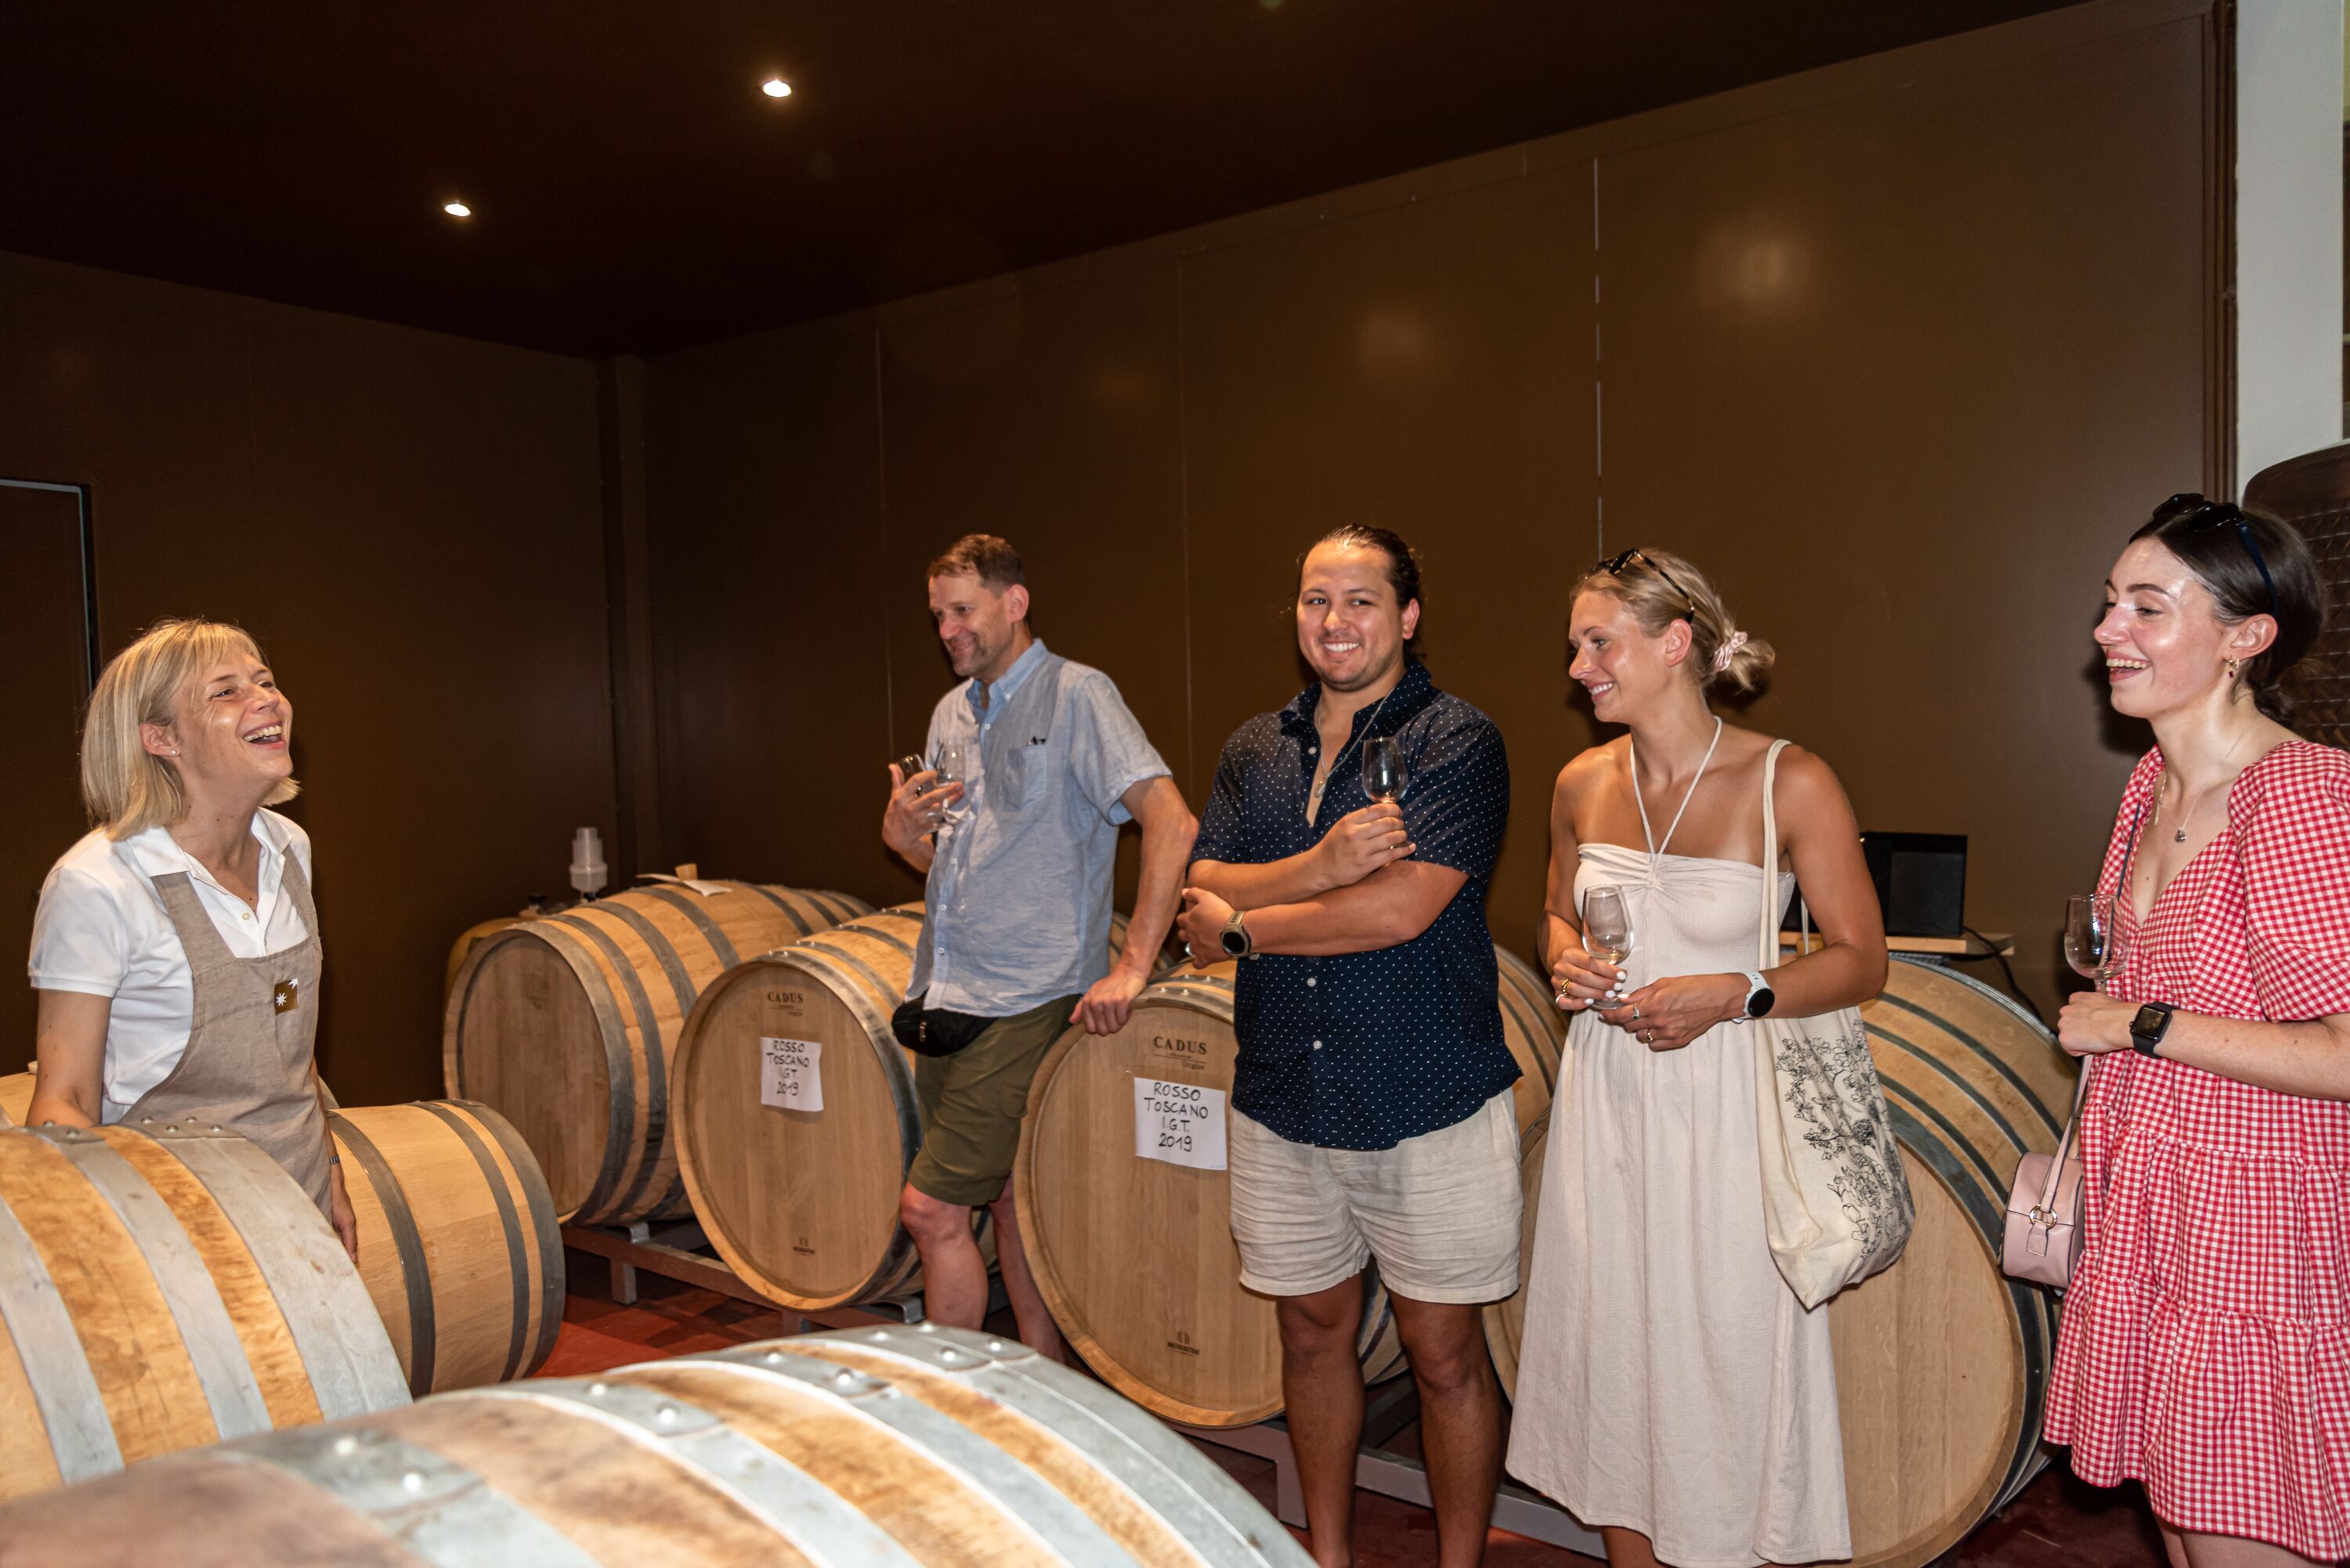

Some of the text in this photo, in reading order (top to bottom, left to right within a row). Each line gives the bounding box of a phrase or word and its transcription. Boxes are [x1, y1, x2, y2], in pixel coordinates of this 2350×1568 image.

[768, 992, 804, 1003] CADUS
[773, 1040, 805, 1053] ROSSO
[1153, 1035, 1207, 1055] CADUS
[766, 1053, 810, 1068] TOSCANO
[1154, 1082, 1201, 1101] ROSSO
[1144, 1097, 1209, 1119] TOSCANO
[1158, 1133, 1192, 1152] 2019
